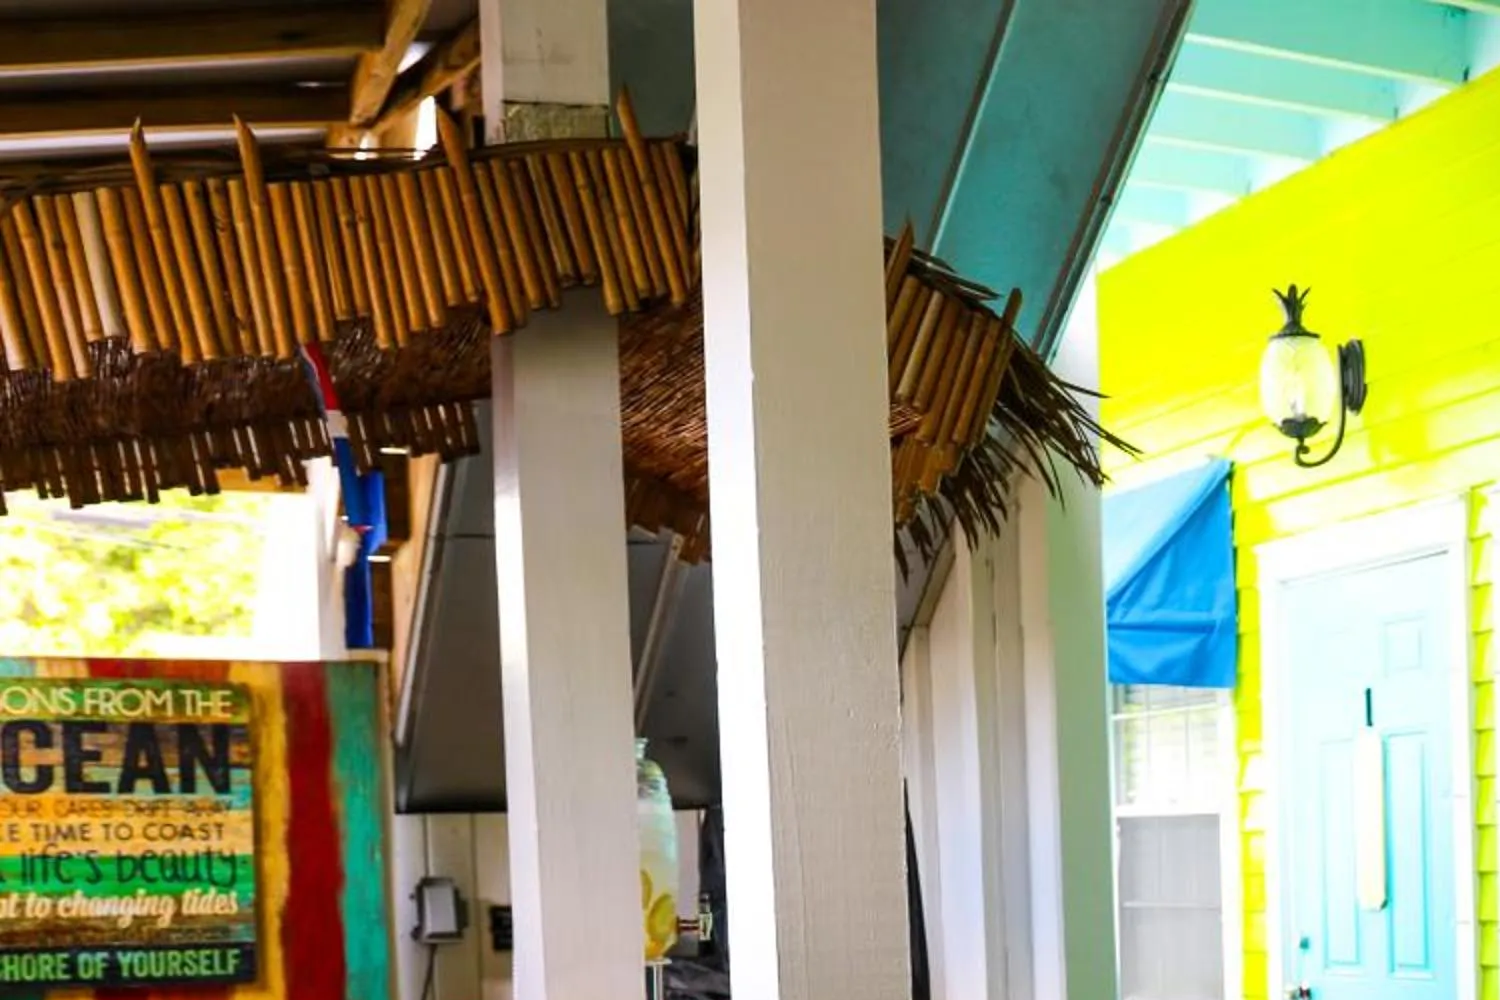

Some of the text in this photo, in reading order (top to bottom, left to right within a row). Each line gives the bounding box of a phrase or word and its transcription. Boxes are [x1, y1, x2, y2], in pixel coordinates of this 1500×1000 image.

[83, 688, 173, 718] FROM
[178, 690, 233, 718] THE
[2, 719, 232, 794] CEAN
[30, 822, 92, 842] TIME
[102, 822, 134, 841] TO
[142, 822, 225, 842] COAST
[21, 842, 103, 886] life's
[116, 848, 238, 888] beauty
[26, 892, 51, 919] to
[57, 888, 177, 929] changing
[181, 886, 239, 916] tides
[0, 948, 241, 981] HORE OF YOURSELF
